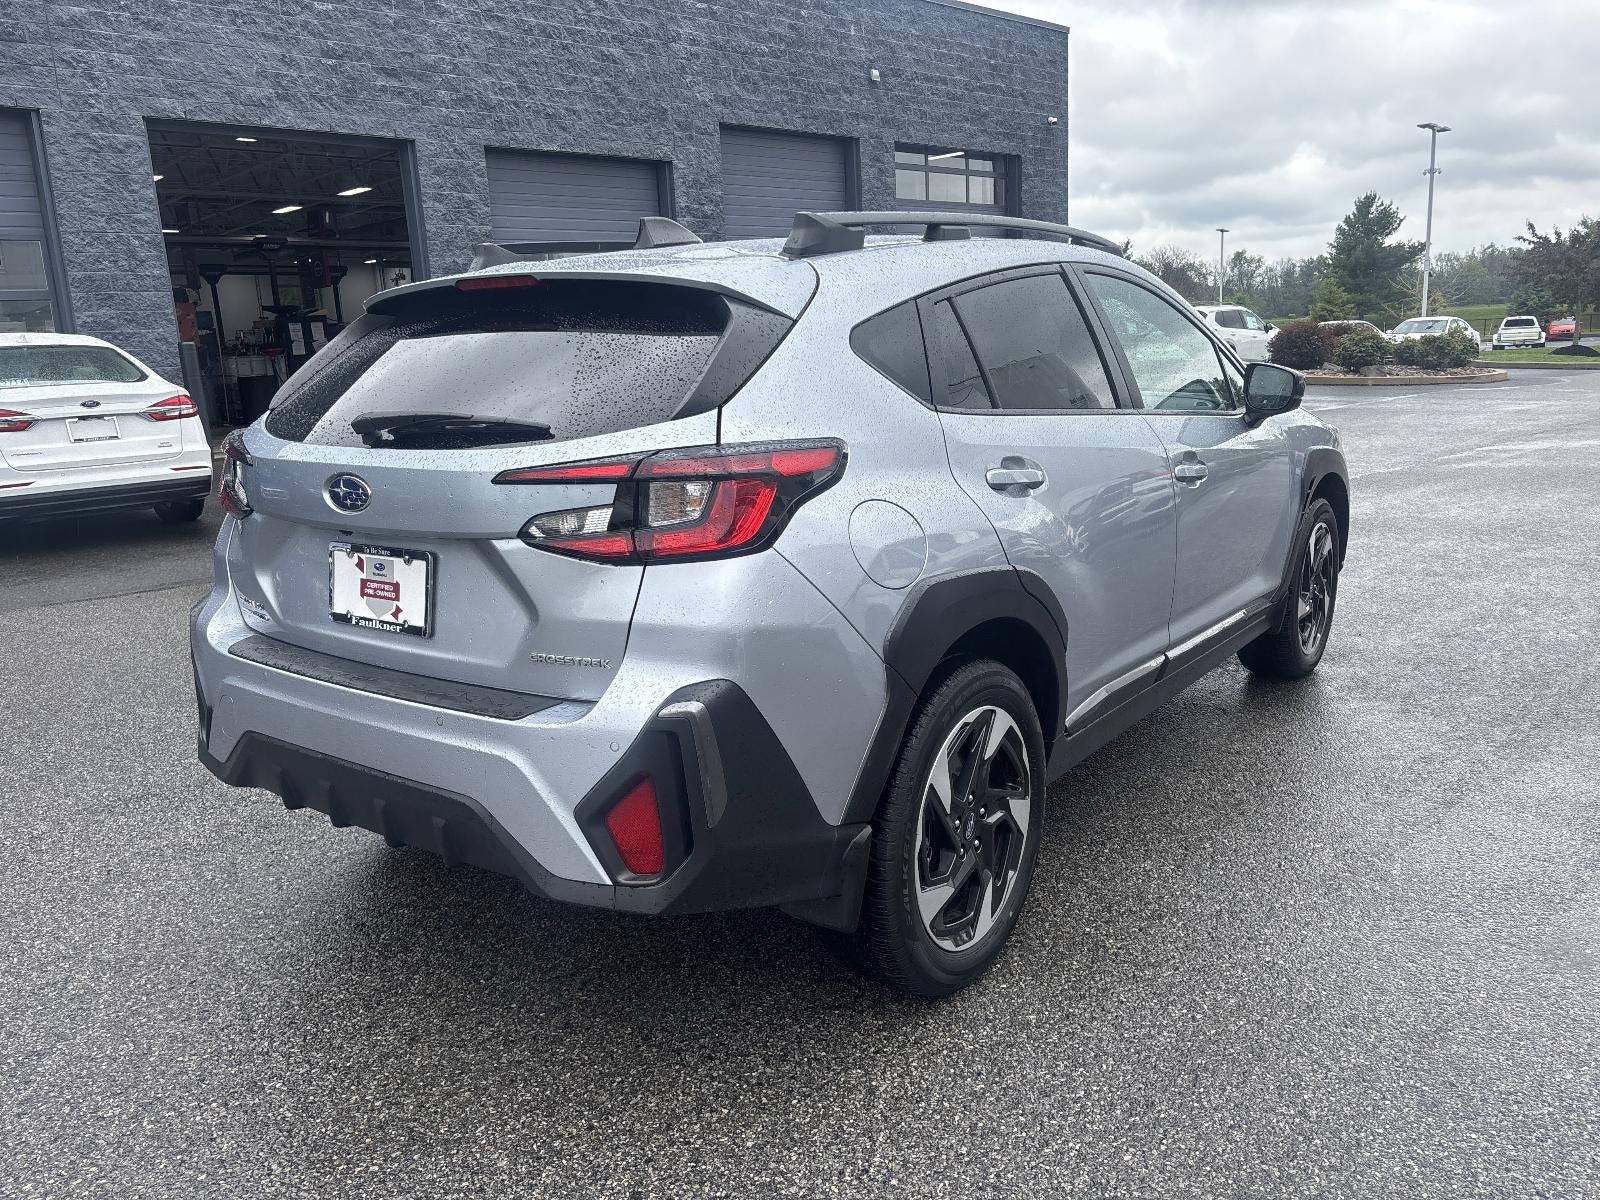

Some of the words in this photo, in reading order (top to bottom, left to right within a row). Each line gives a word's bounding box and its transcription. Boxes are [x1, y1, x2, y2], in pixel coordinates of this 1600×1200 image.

[366, 582, 393, 591] CERTIFIED
[364, 589, 395, 598] PRE-OWNED
[352, 616, 402, 632] Faulkner
[529, 652, 611, 669] CROSSTREK
